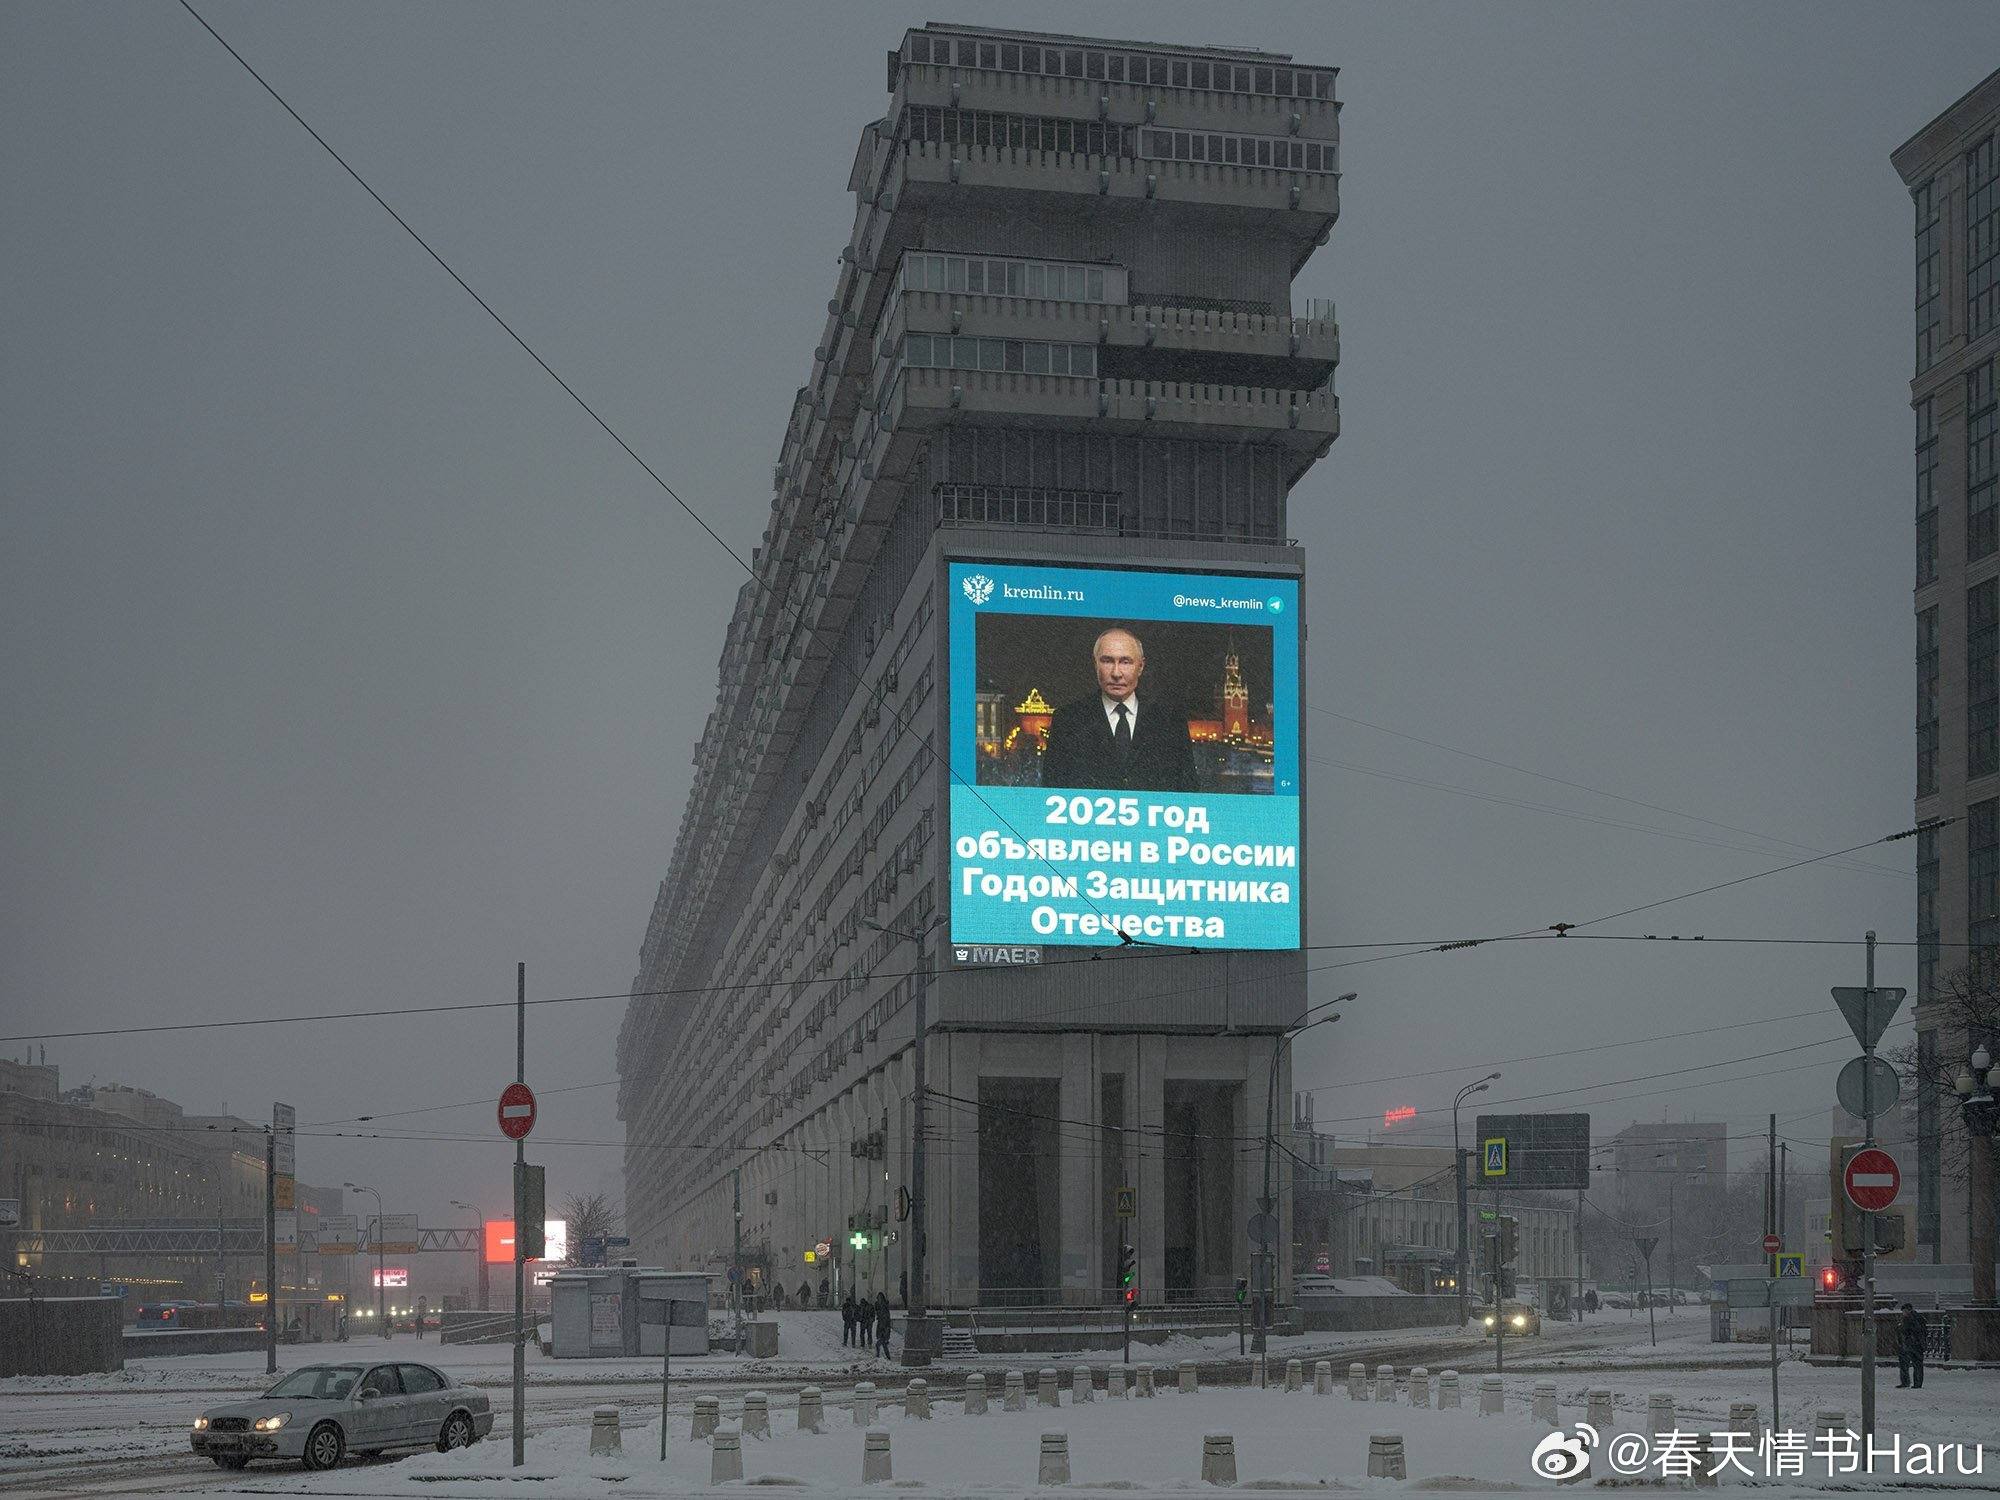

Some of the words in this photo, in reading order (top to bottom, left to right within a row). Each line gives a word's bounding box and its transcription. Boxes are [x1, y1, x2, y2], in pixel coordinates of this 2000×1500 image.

[1003, 583, 1084, 601] kremlin.ru
[1173, 594, 1263, 610] @news_kremlin
[1045, 795, 1139, 826] 2025
[1148, 804, 1210, 833] год
[956, 831, 1132, 863] объявлен
[1140, 841, 1160, 863] в
[1168, 836, 1295, 867] России
[962, 867, 1078, 903] Годом
[1086, 870, 1290, 905] Защитника
[1031, 906, 1225, 938] Отечества
[973, 947, 1040, 963] MAER
